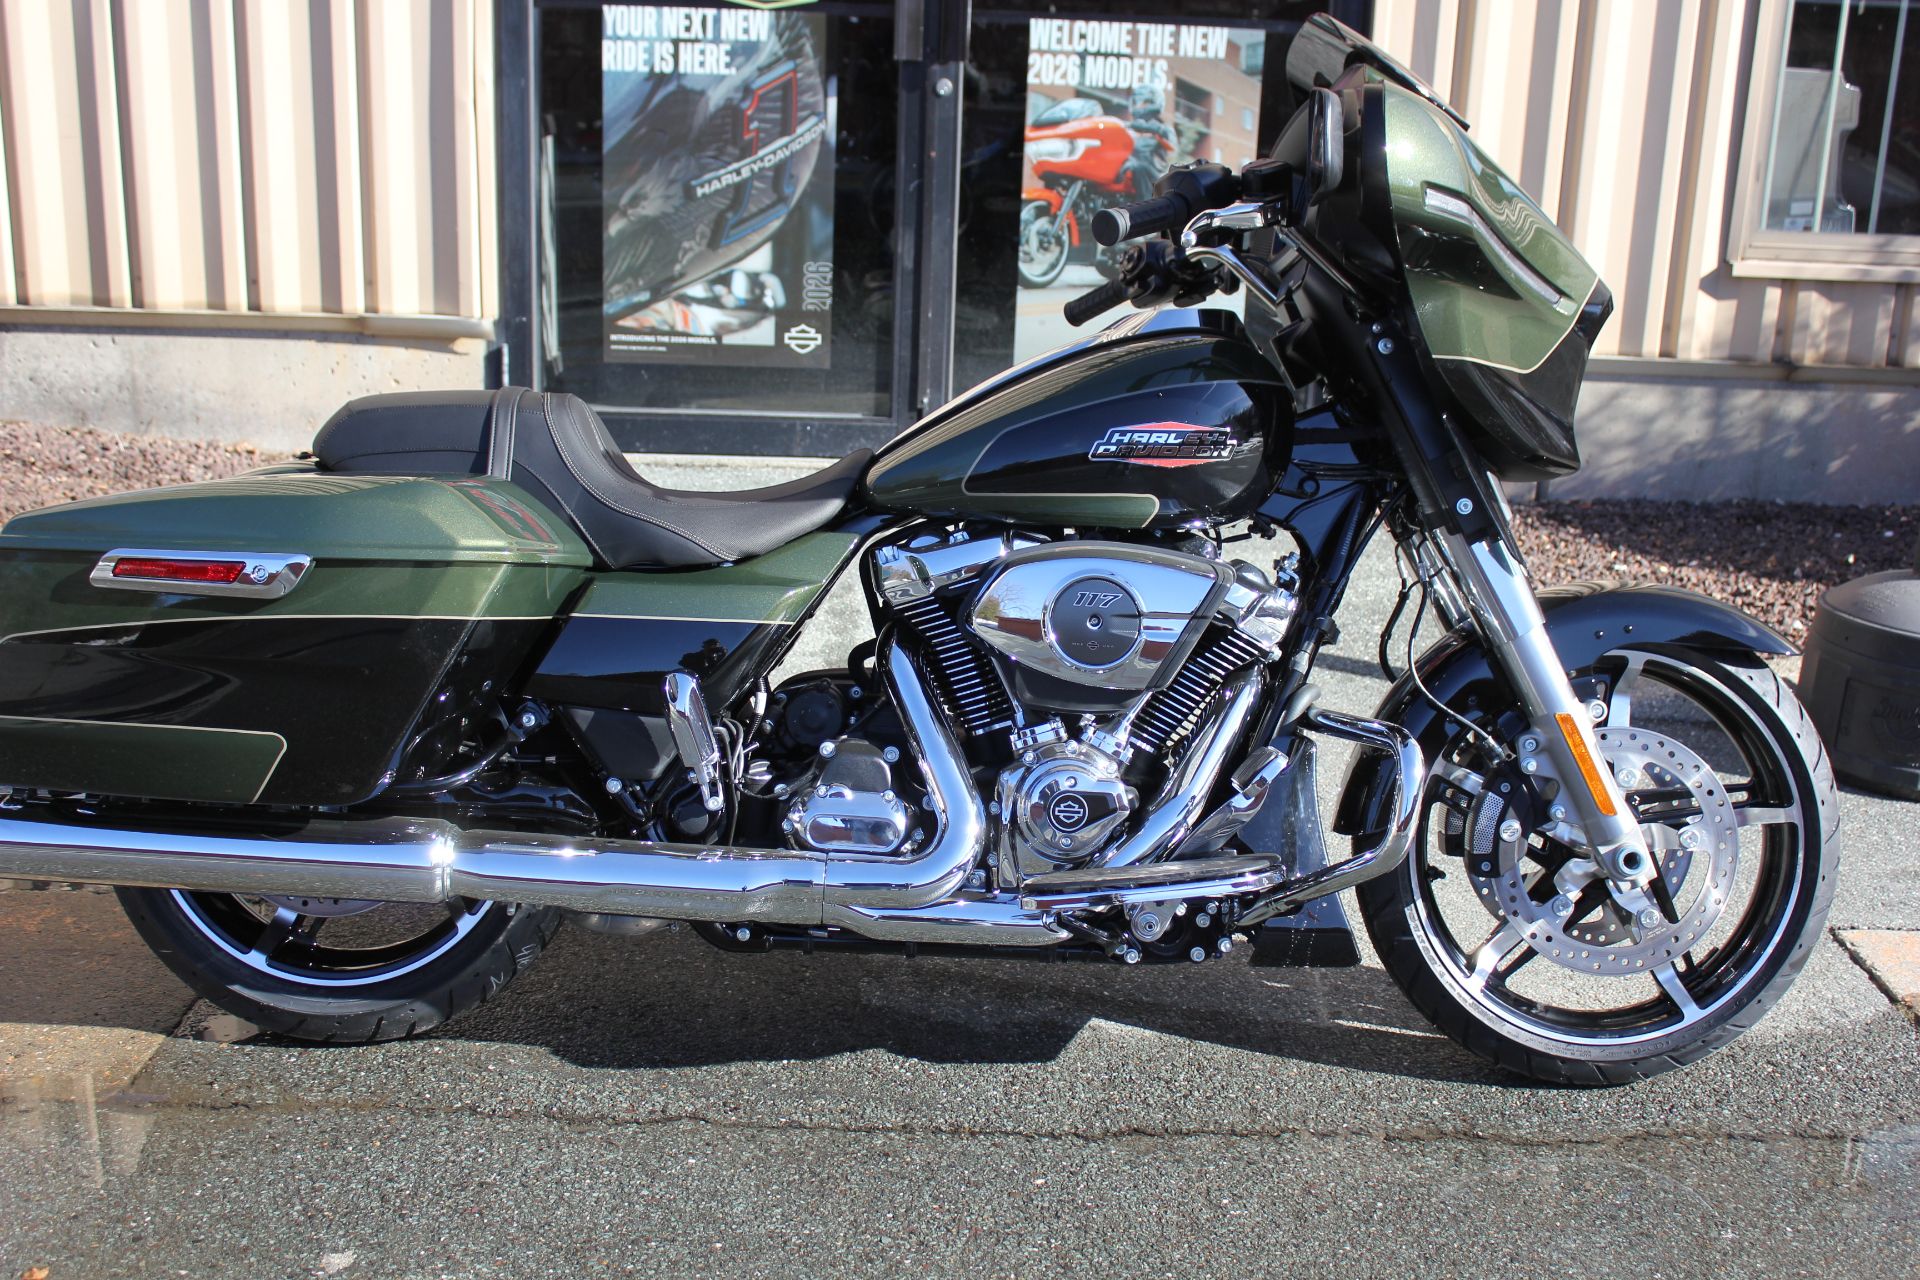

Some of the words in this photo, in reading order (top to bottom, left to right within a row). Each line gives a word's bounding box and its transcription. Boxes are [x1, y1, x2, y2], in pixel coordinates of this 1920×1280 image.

[602, 5, 657, 37] YOUR
[662, 7, 717, 39] NEXT
[720, 9, 769, 41] NEW
[1029, 18, 1131, 54] WELCOME
[1136, 23, 1175, 57] THE
[1179, 25, 1228, 60] NEW
[602, 40, 651, 72] RIDE
[653, 42, 675, 73] IS
[678, 43, 737, 75] HERE.
[1028, 53, 1081, 86] 2026
[1085, 56, 1173, 91] MODELS.
[695, 121, 828, 197] HARLEY-DAVIDSON
[802, 261, 833, 312] 2026
[1096, 445, 1232, 457] DAVIDSON
[1111, 432, 1226, 444] HARLEY-
[1073, 591, 1123, 608] 117
